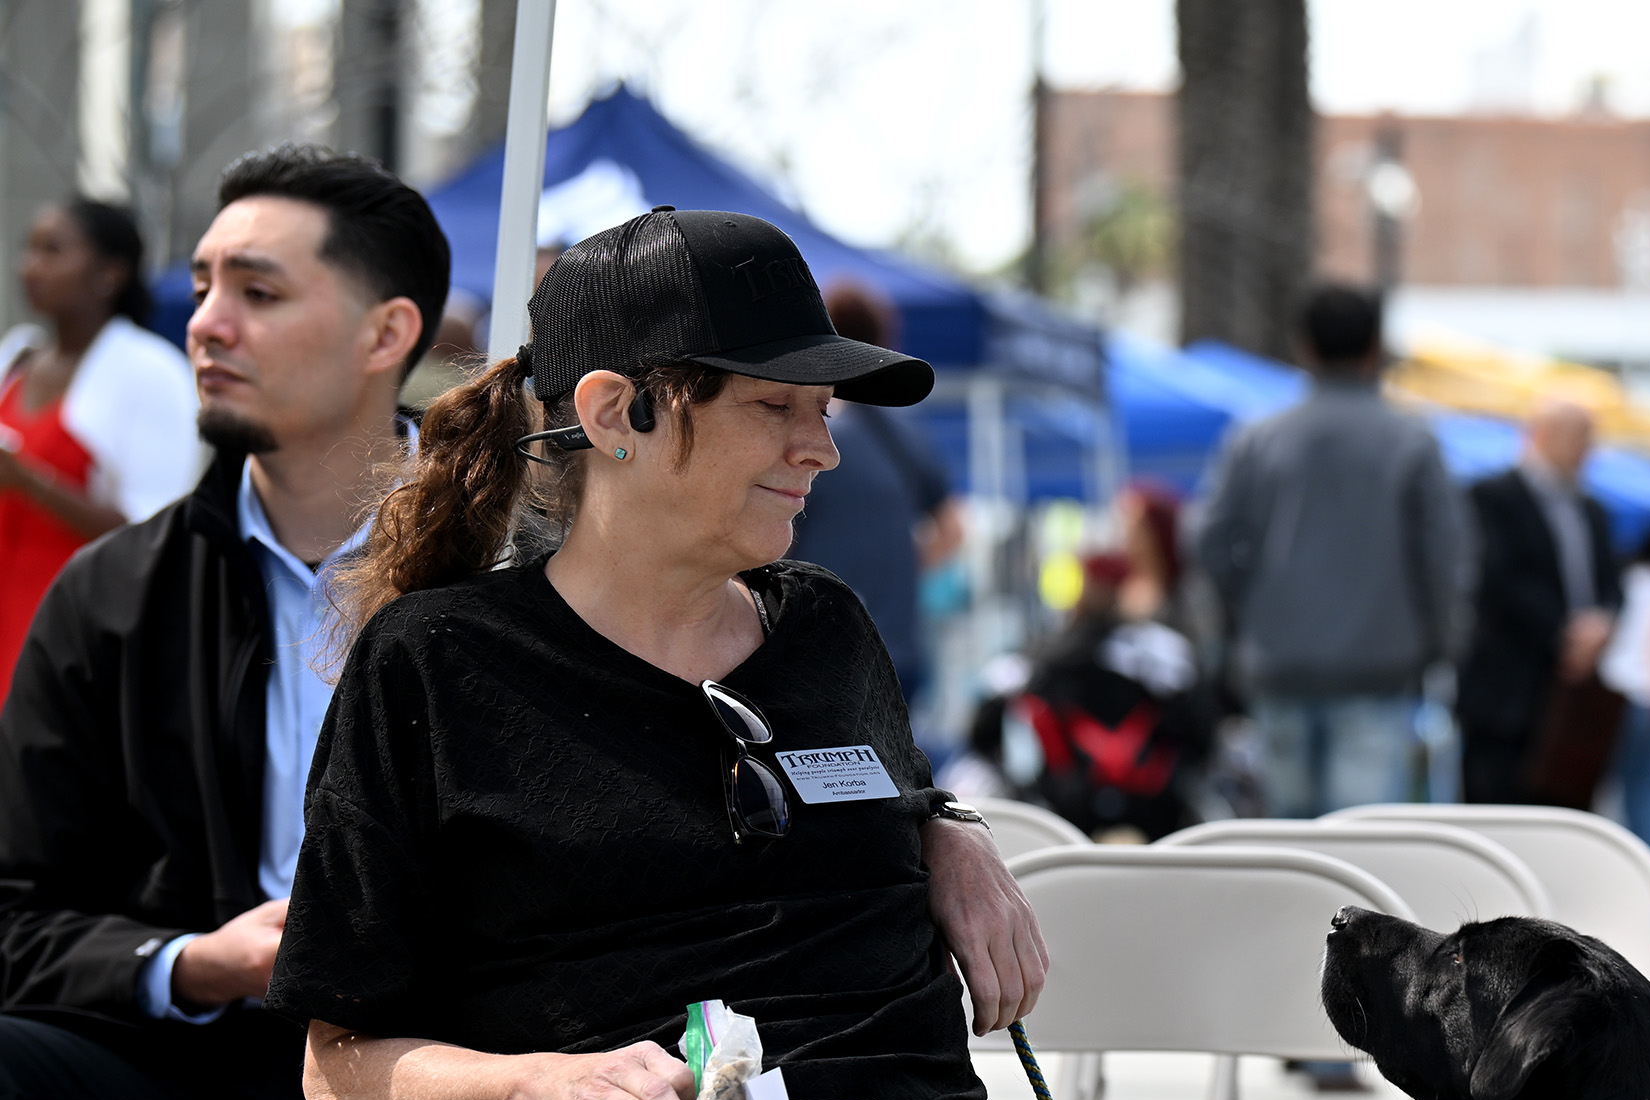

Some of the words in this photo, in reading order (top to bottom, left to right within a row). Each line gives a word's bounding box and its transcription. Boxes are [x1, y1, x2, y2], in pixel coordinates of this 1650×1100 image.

[729, 256, 815, 304] TRIU
[781, 749, 876, 768] TRIUMPH
[807, 761, 860, 769] FOUNDATION
[822, 781, 839, 789] Jen
[839, 780, 867, 788] Korba
